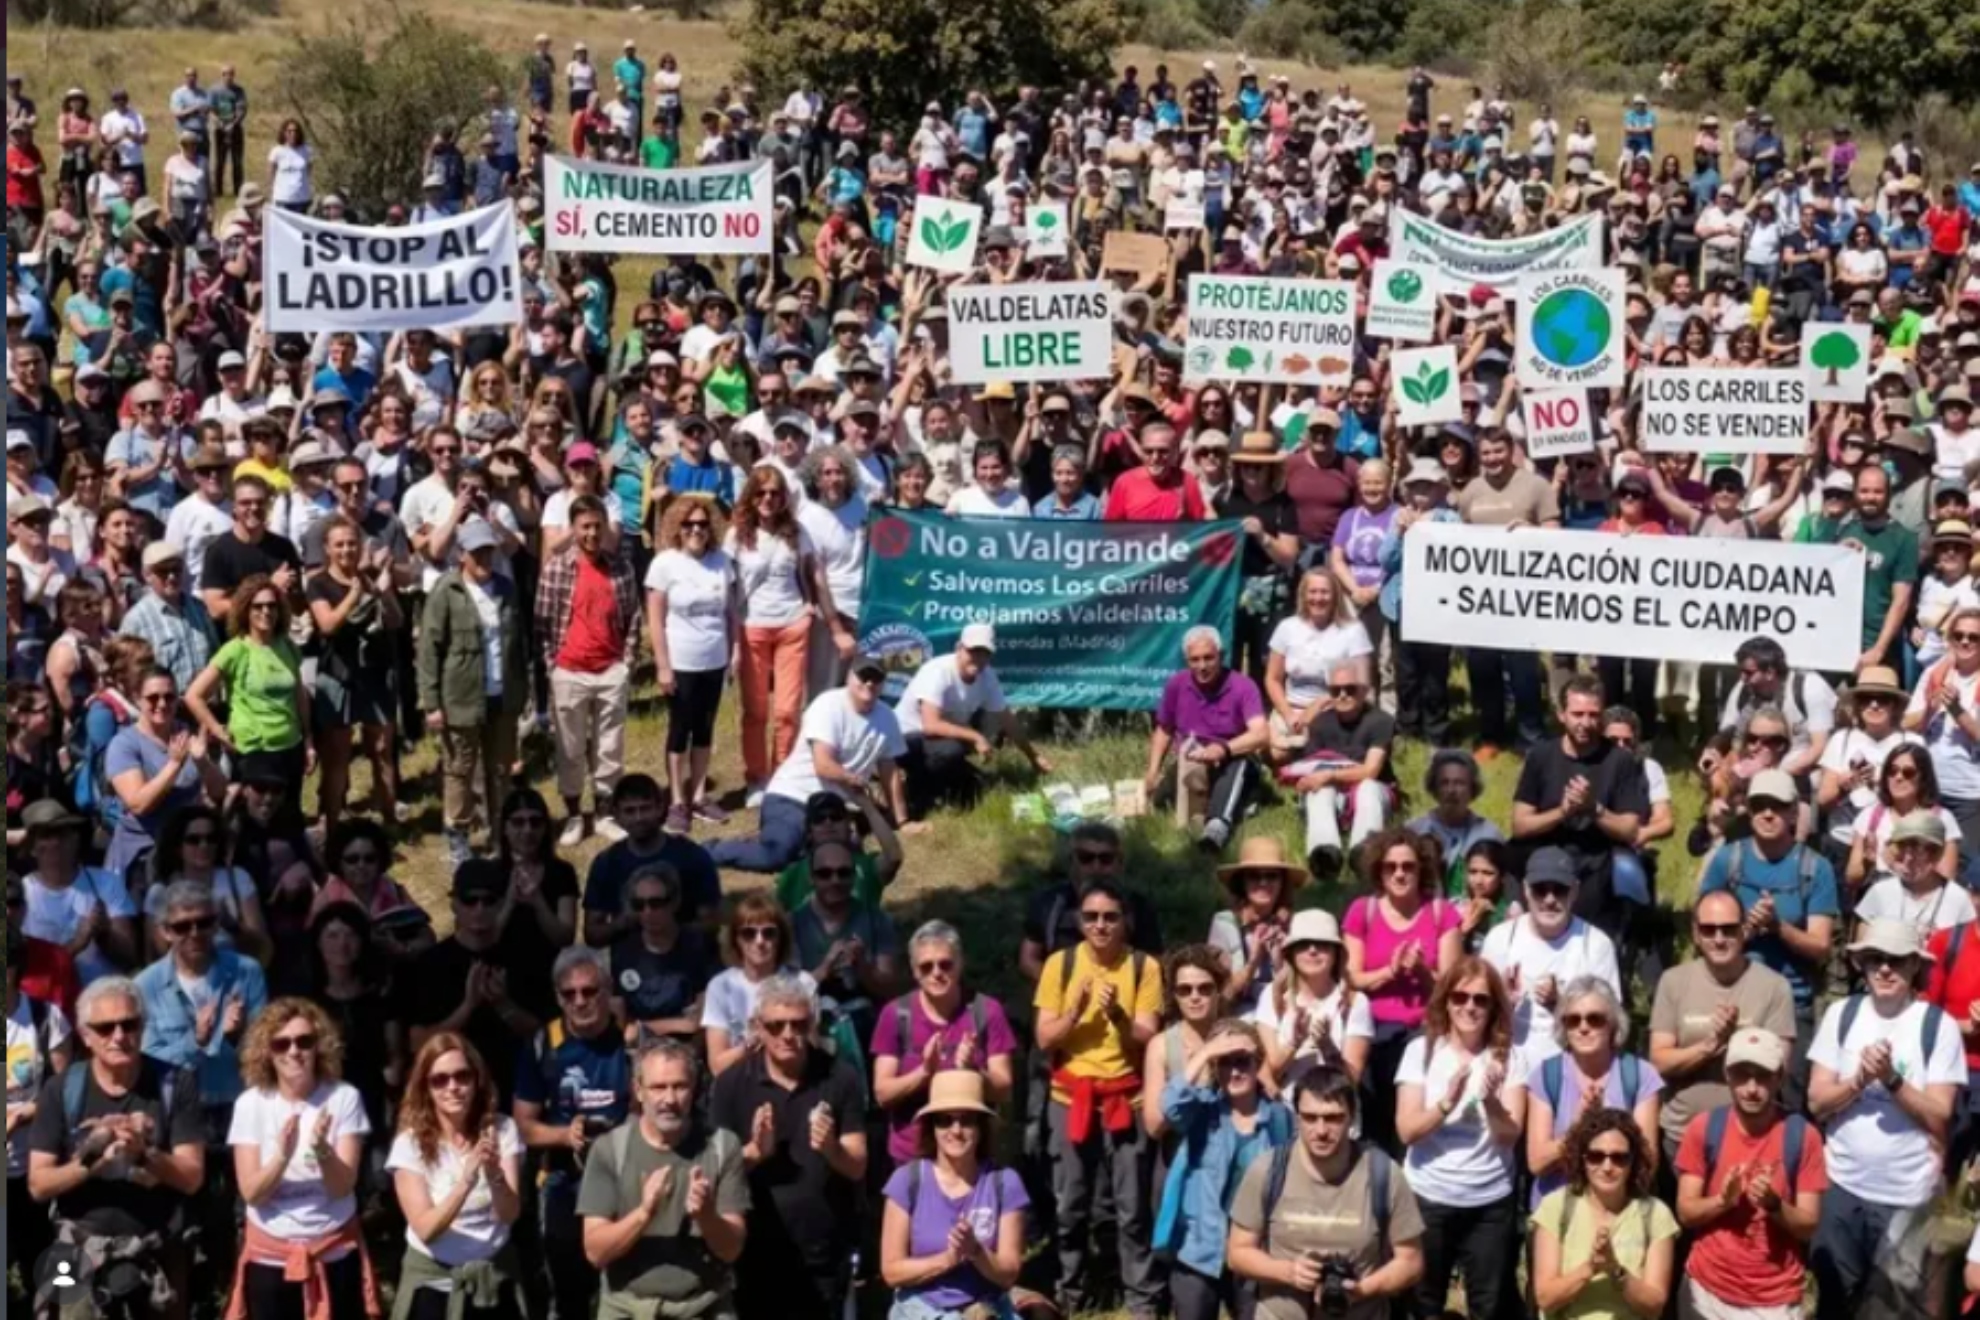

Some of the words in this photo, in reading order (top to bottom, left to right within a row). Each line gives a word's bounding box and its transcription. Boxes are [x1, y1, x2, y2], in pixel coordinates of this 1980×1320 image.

[563, 170, 753, 201] NATURALEZA
[556, 204, 588, 239] SÍ,
[595, 211, 717, 238] CEMENTO
[724, 212, 760, 238] NO
[302, 230, 426, 267] ¡STOP
[437, 225, 490, 262] AL
[278, 265, 513, 310] LADRILLO!
[1198, 280, 1348, 315] PROTÉJANOS
[951, 293, 1108, 323] VALDELATAS
[1190, 318, 1274, 342] NUESTRO
[1279, 320, 1353, 346] FUTURO
[983, 331, 1082, 368] LIBRE
[1647, 378, 1690, 402] LOS
[1697, 379, 1804, 403] CARRILES
[1533, 397, 1579, 430] NO
[1647, 413, 1677, 436] NO
[1684, 413, 1711, 436] SE
[1717, 413, 1804, 438] VENDEN
[920, 526, 969, 558] No
[978, 535, 998, 559] a
[1007, 531, 1190, 570] Valgrande
[928, 570, 1045, 595] Salvemos
[1052, 575, 1094, 596] Los
[1100, 574, 1189, 595] Carriles
[1424, 545, 1640, 584] MOVILIZACIÓN
[1650, 559, 1836, 597] CIUDADANA
[924, 600, 1062, 625] Protejamos
[1067, 603, 1189, 624] Valdelatas
[1457, 585, 1623, 624] SALVEMOS
[1633, 598, 1671, 627] EL
[1680, 601, 1797, 635] CAMPO
